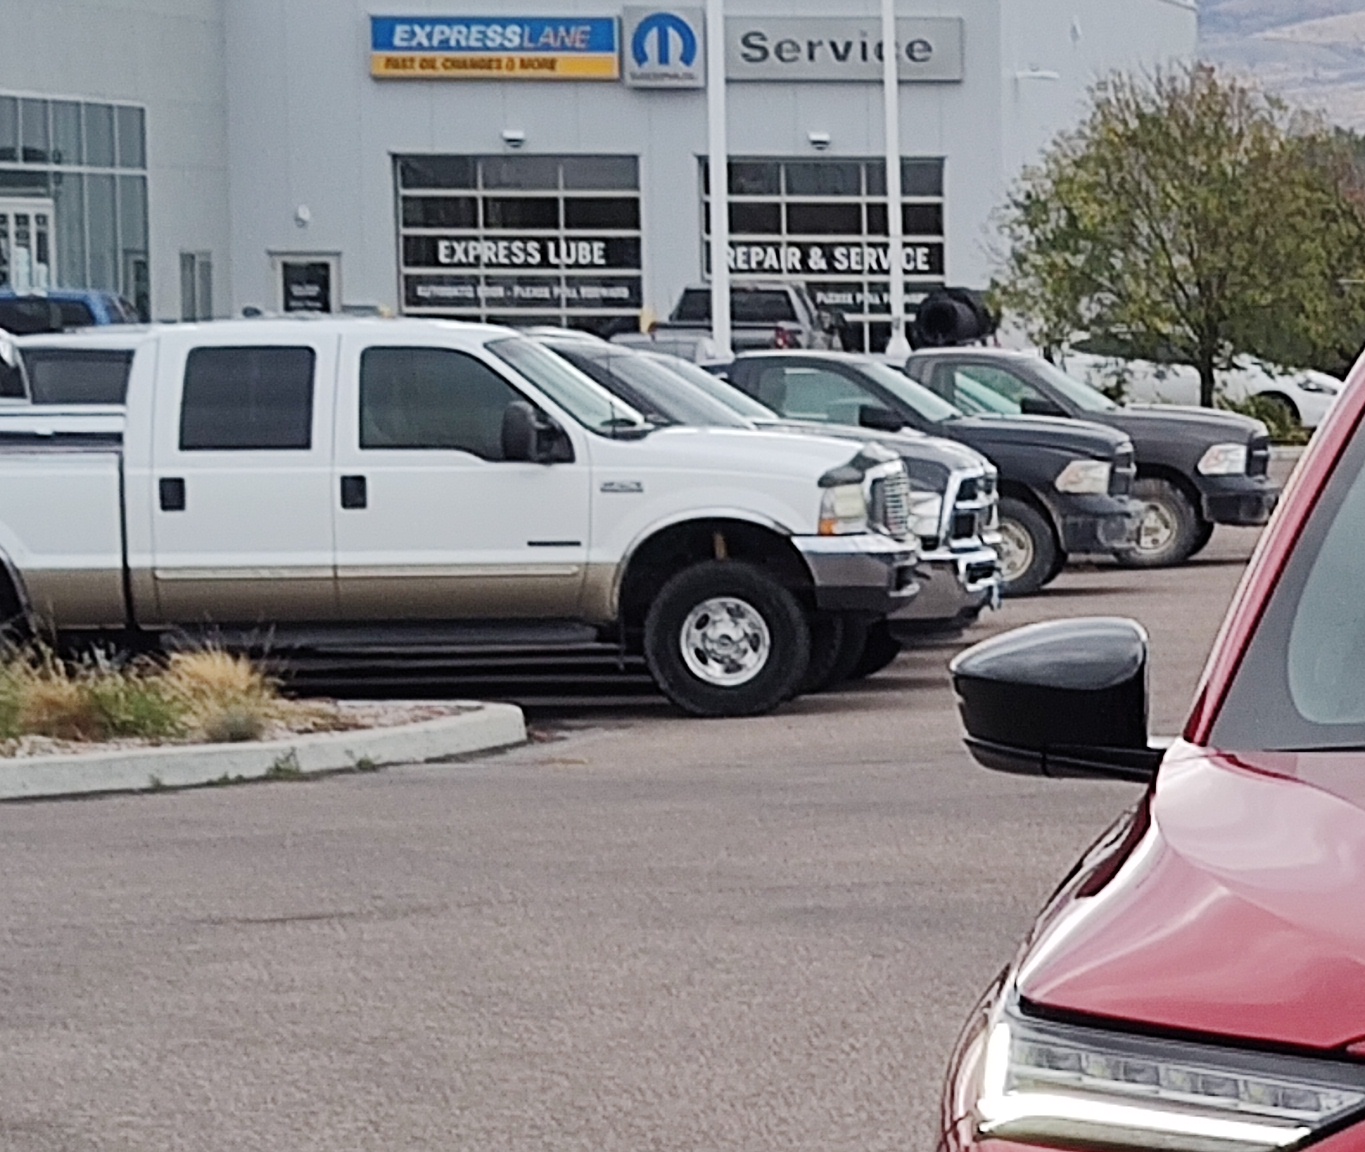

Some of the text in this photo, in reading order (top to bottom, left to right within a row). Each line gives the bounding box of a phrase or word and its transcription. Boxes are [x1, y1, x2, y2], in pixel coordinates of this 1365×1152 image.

[437, 240, 606, 265] EXPRESS LUBE
[808, 246, 828, 271] &
[833, 246, 930, 271] SERVCE
